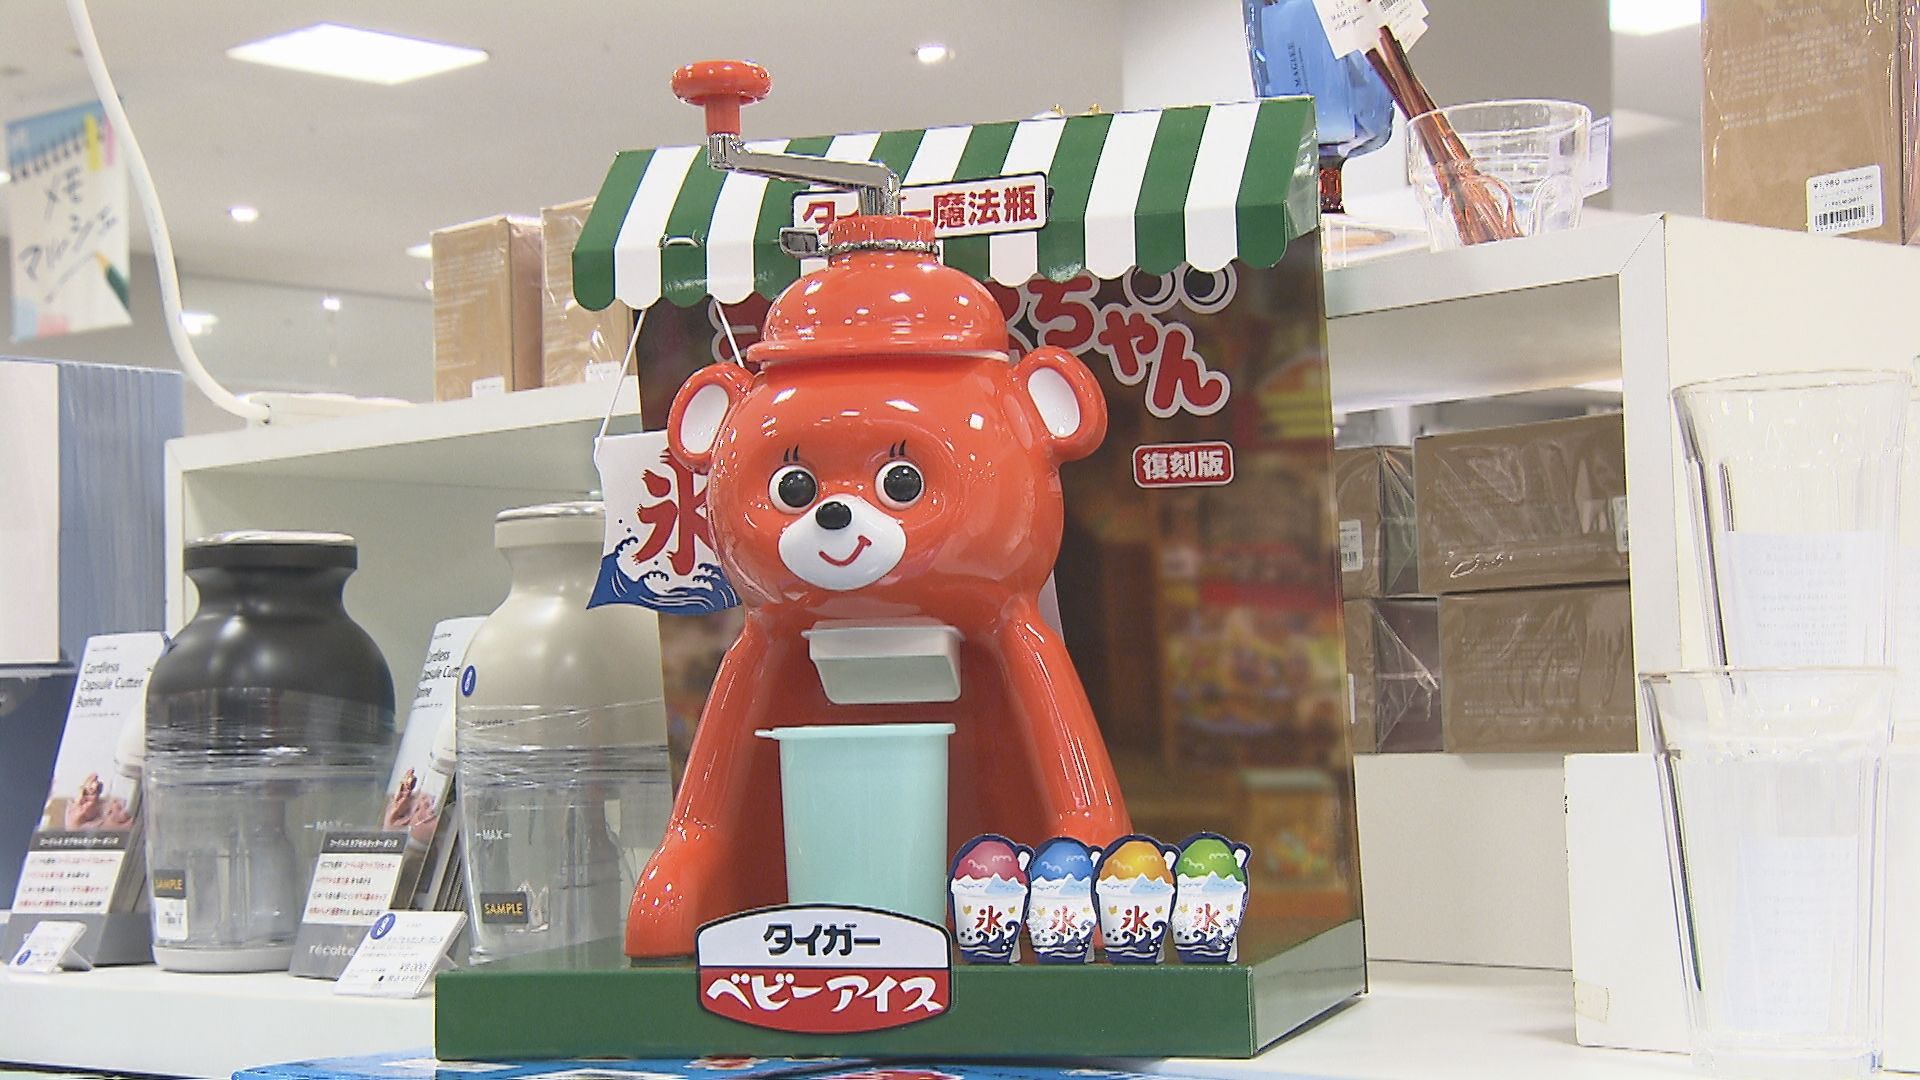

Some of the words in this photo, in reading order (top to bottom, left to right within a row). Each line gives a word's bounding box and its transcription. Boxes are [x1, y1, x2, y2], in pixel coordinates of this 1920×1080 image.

[1141, 448, 1226, 480] 復刻版
[632, 447, 715, 577] 氷
[484, 903, 524, 916] SAMPLE
[975, 905, 1003, 934] 氷
[1050, 905, 1077, 933] 氷
[1120, 905, 1150, 934] 氷
[1192, 903, 1221, 932] 氷
[763, 924, 882, 957] タイガー
[705, 975, 944, 1013] ベビーアイス
